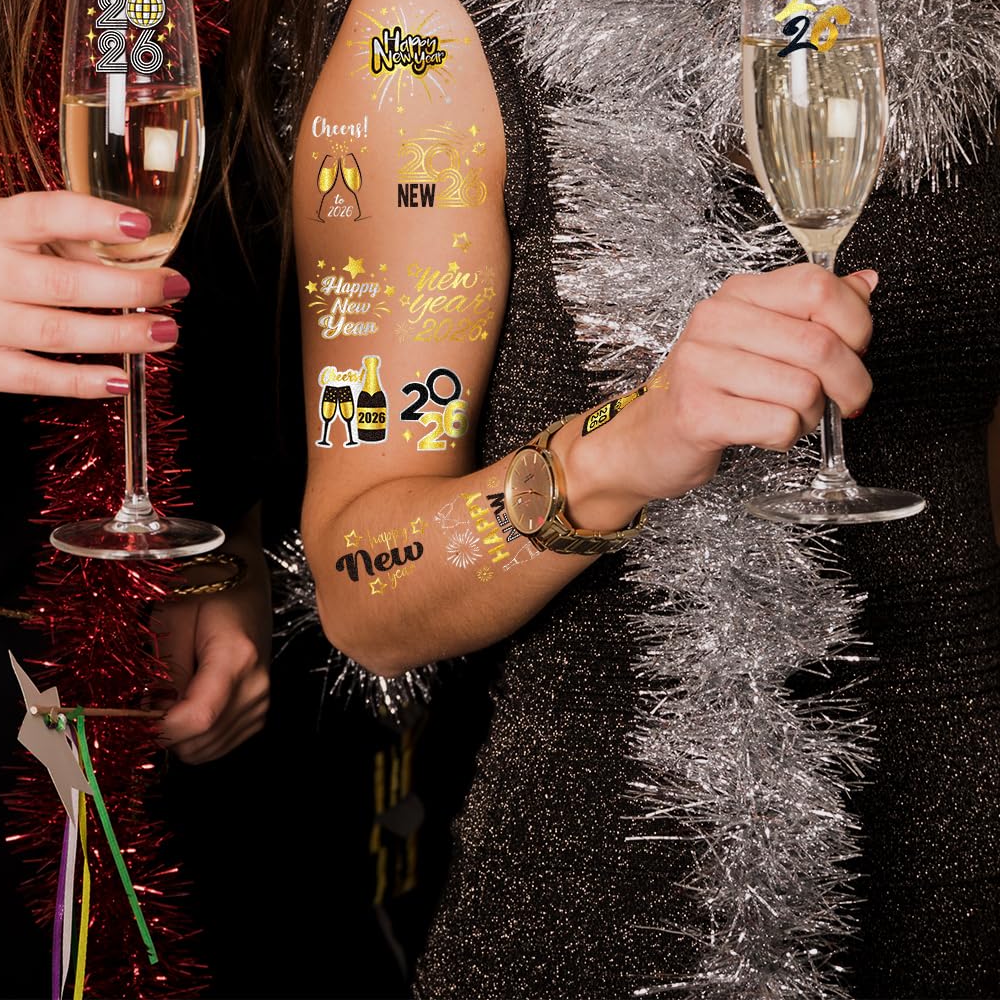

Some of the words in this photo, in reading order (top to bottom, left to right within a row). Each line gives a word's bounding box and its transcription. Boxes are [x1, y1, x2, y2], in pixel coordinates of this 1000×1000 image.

[95, 29, 164, 74] 26
[371, 36, 412, 74] New
[411, 49, 446, 76] Year
[382, 26, 438, 60] Happy
[311, 115, 369, 139] Cheers!
[397, 142, 461, 183] 20
[334, 194, 344, 205] to
[397, 183, 436, 208] NEW
[436, 167, 488, 209] 26
[327, 205, 353, 217] 2026
[319, 276, 380, 297] Happy
[331, 298, 371, 314] New
[318, 315, 380, 339] Year
[413, 318, 488, 342] 2026
[401, 368, 462, 421] 20
[358, 412, 386, 424] 2026
[417, 400, 469, 451] 26
[460, 492, 510, 563] HAPPY
